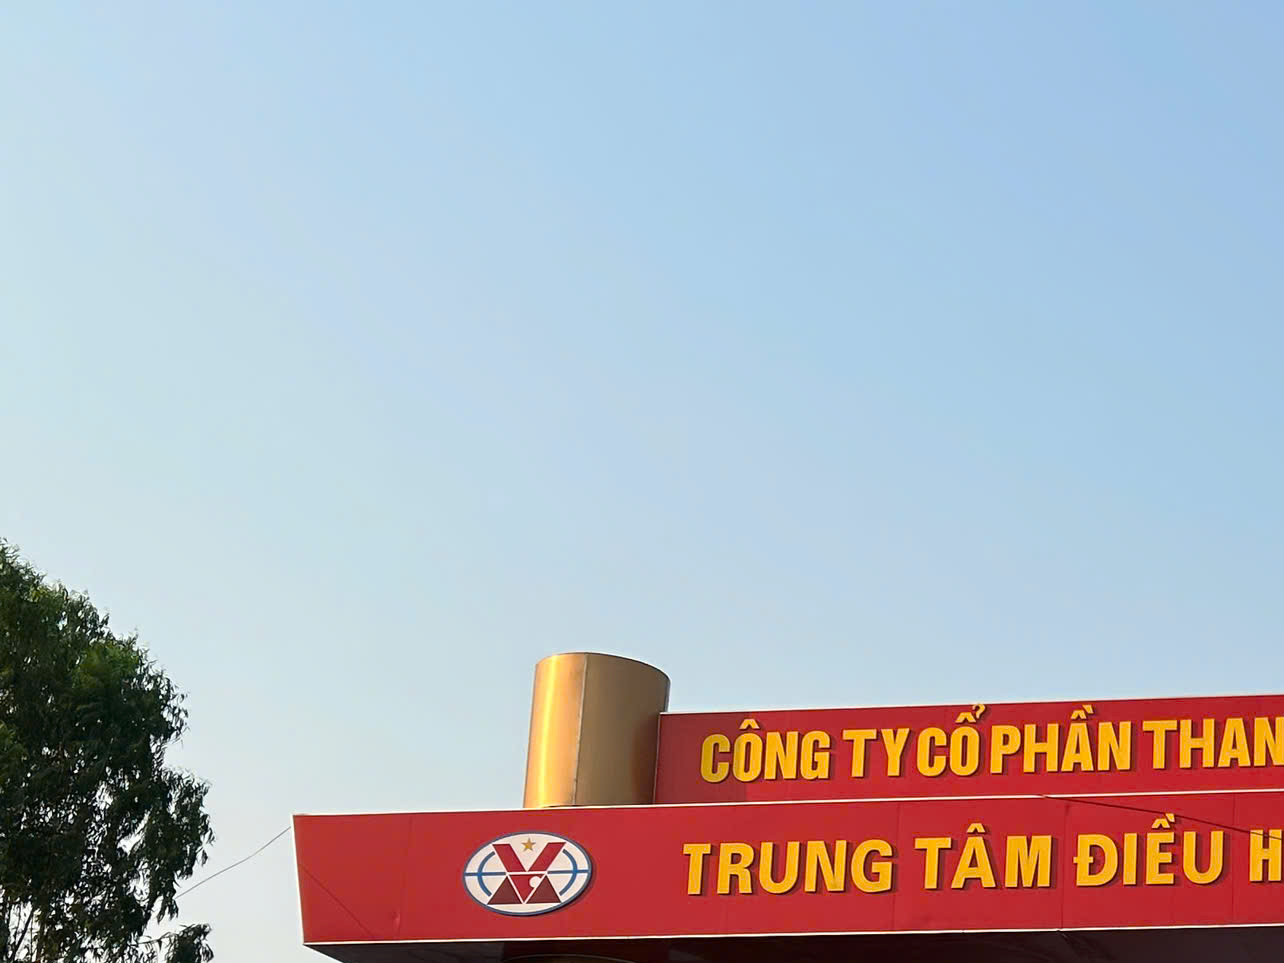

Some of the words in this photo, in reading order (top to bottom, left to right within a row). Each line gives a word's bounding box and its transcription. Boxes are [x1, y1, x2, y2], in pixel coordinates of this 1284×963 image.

[701, 719, 831, 784] CÔNG
[843, 728, 911, 778] TY
[917, 704, 986, 777] CỔ
[991, 705, 1132, 774] PHẦN
[683, 839, 894, 896] TRUNG
[915, 823, 1053, 890] TÂM
[1074, 813, 1225, 887] ĐIỀU
